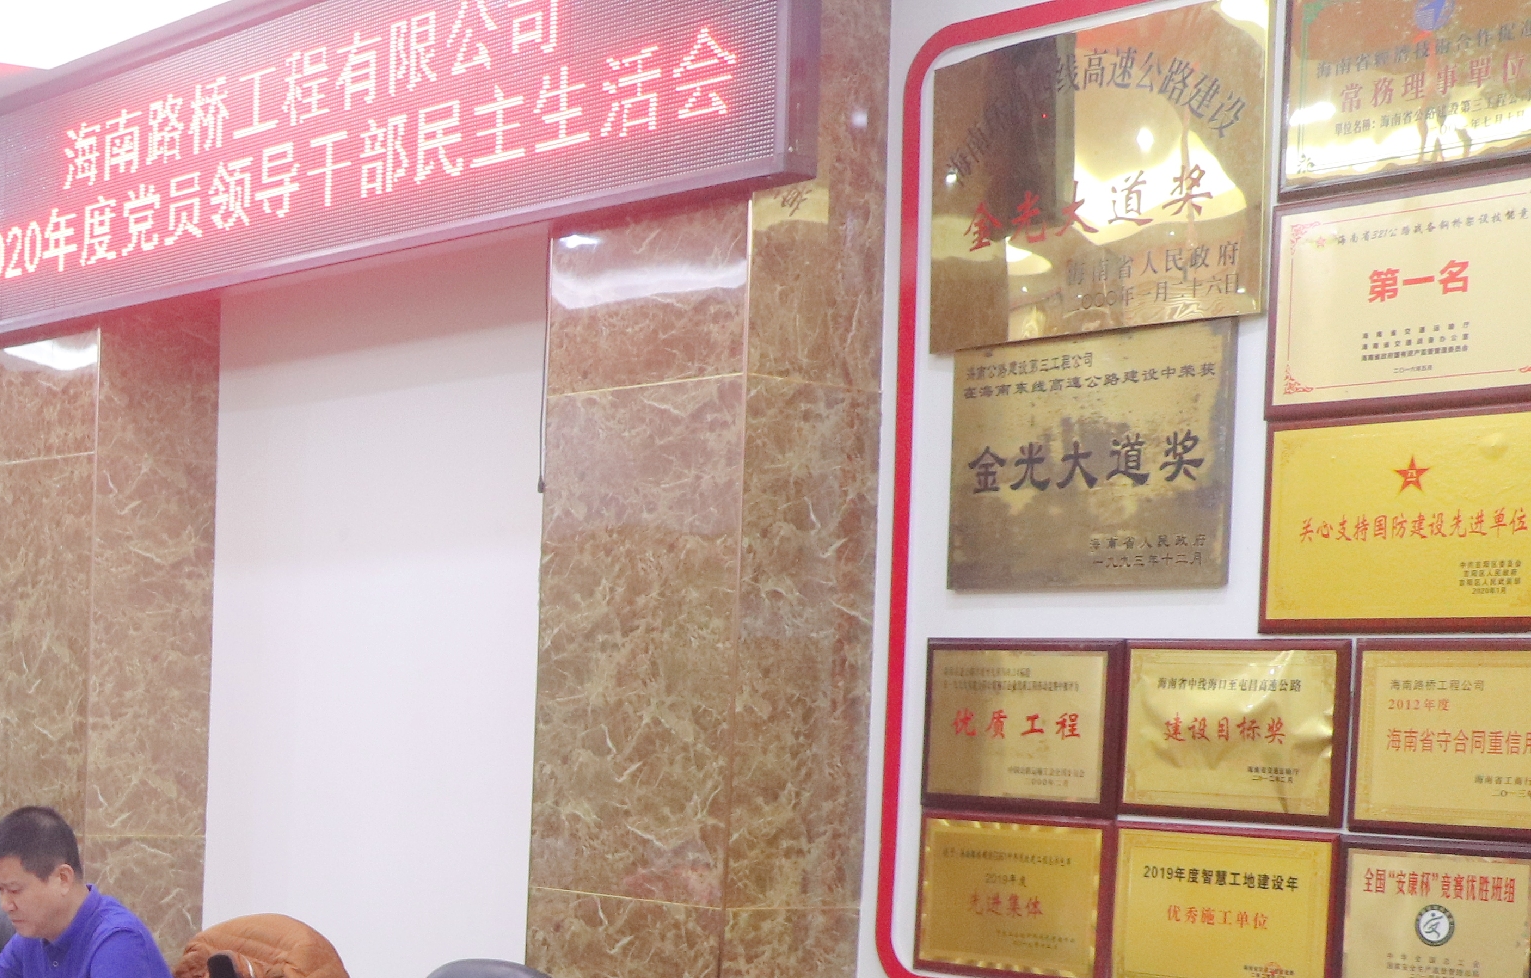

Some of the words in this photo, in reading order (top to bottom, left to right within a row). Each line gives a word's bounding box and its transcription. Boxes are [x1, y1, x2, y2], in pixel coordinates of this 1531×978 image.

[62, 0, 560, 190] 海南路桥工程有限公司
[1368, 259, 1470, 303] 第一名
[968, 429, 1205, 494] 金光大道奖
[1299, 507, 1529, 544] 关心支持国防建设先进单位
[1388, 698, 1450, 712] 2012年度
[952, 708, 1081, 740] 优质工程
[1164, 711, 1286, 745] 建设目标奖
[1143, 865, 1299, 892] 2019年度智慧工地建设年
[1363, 868, 1517, 903] 全国“安康杯”竞赛优胜班组
[968, 889, 1044, 919] 先进集体
[1167, 905, 1269, 930] 优秀施工单位
